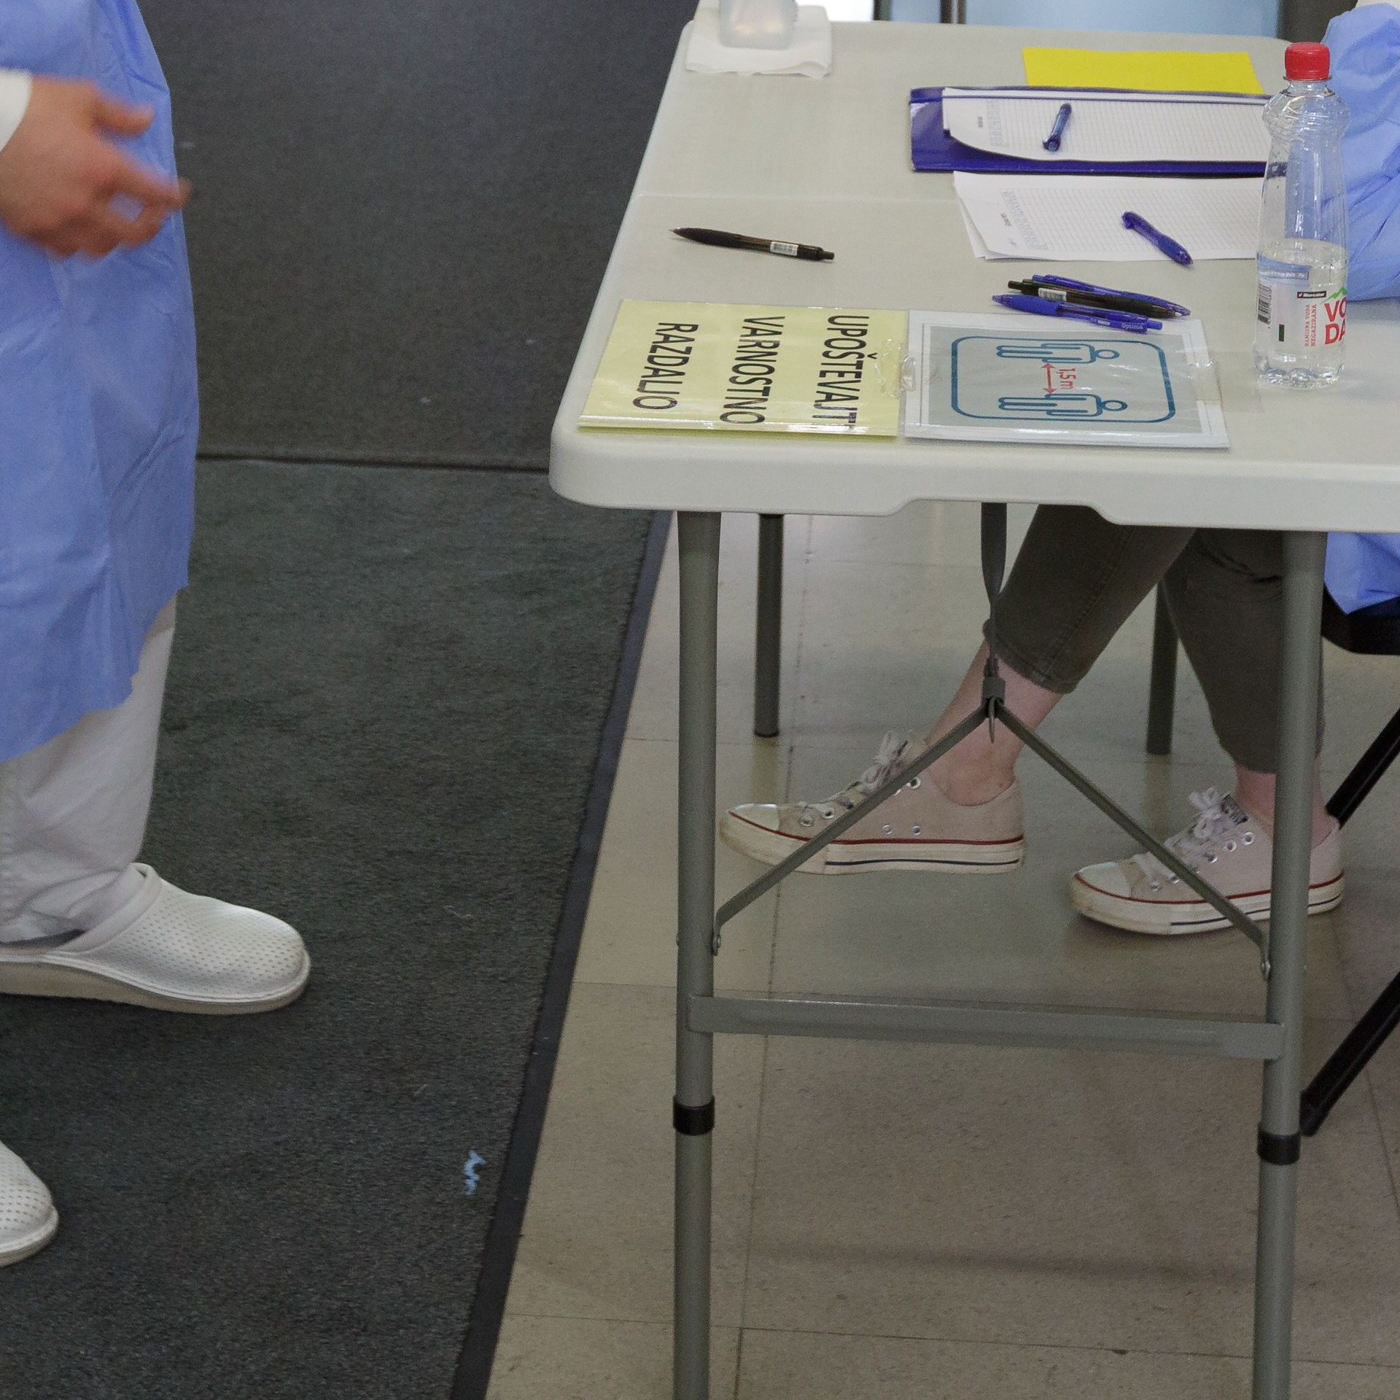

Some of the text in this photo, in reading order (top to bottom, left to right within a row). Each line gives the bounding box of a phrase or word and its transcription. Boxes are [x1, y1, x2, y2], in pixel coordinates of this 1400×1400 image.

[632, 321, 699, 410] RAZDALJO
[719, 315, 786, 425] VARNOSTNO
[811, 314, 879, 429] UPOŠTEVAJT
